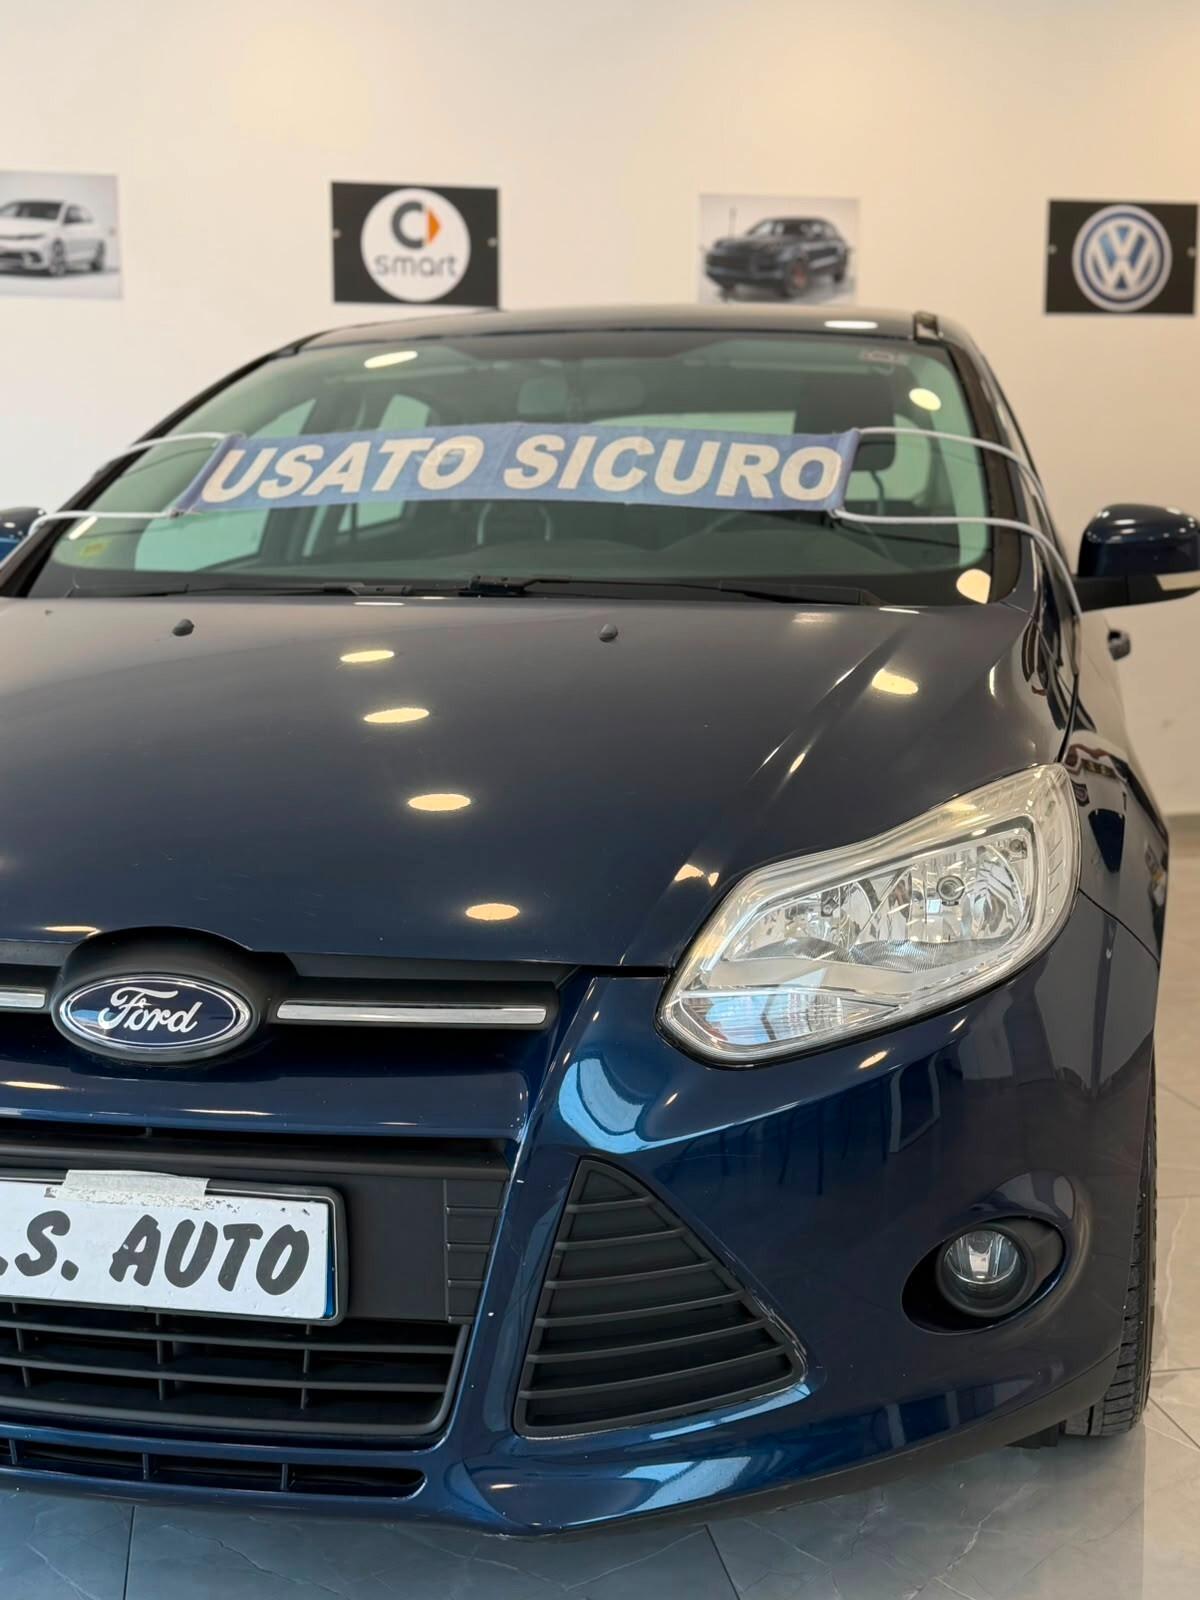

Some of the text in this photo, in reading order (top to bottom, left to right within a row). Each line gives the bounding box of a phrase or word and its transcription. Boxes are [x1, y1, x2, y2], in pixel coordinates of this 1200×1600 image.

[374, 253, 458, 277] smart
[201, 434, 843, 503] USATO SICURO
[98, 986, 203, 1033] Ford
[109, 1214, 310, 1296] AUTO
